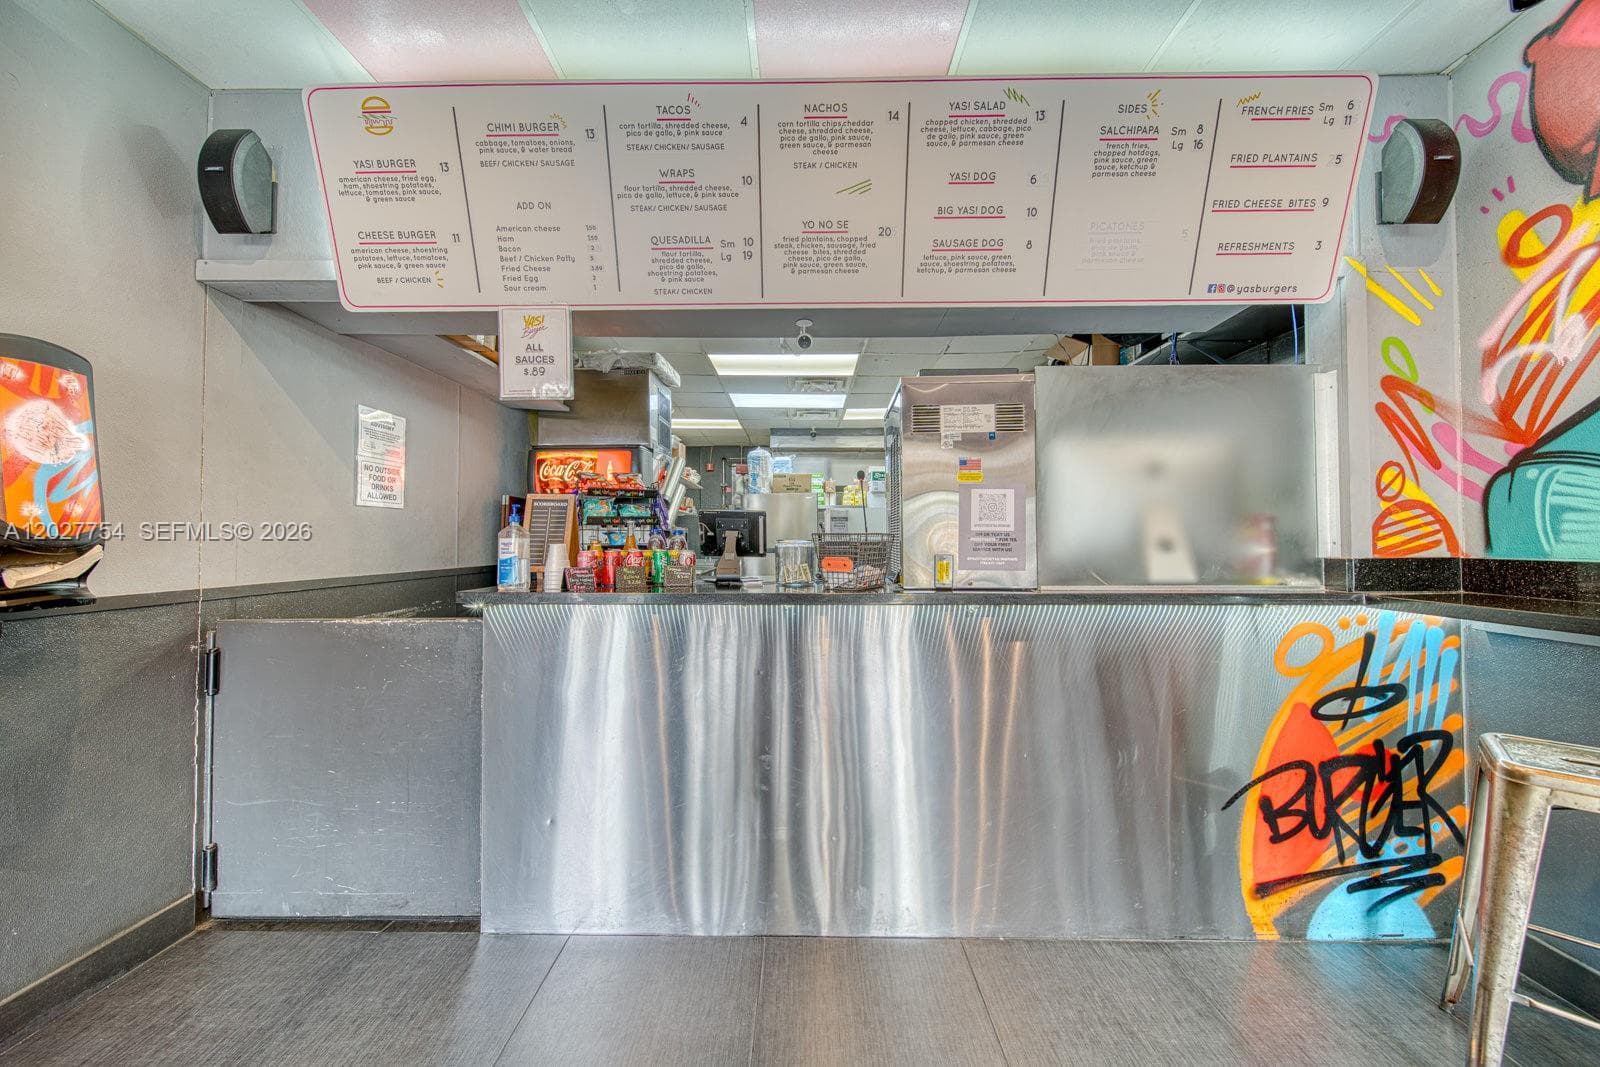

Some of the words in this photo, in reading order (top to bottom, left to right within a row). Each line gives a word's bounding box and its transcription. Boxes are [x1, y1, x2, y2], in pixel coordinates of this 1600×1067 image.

[804, 103, 847, 112] NACHOS
[888, 111, 899, 121] 14
[973, 101, 1006, 111] SALAD
[1035, 110, 1045, 121] 13
[1118, 104, 1147, 113] SIDES
[1242, 106, 1283, 115] FRENCH
[1286, 106, 1314, 115] FRIES
[1319, 103, 1334, 111] Sm
[1346, 100, 1354, 110] 6
[656, 104, 691, 115] TACOS
[740, 116, 747, 126] 4
[993, 118, 1027, 126] shredded
[1323, 116, 1334, 126] Lg
[1344, 115, 1352, 125] 11
[487, 123, 516, 132] CHIMI
[519, 122, 559, 132] BURGER
[585, 129, 595, 139] 13
[665, 122, 699, 130] shredded
[1100, 126, 1159, 135] SALCHIPAPA
[1171, 127, 1186, 136] Sm
[1197, 124, 1203, 134] 8
[1172, 141, 1183, 151] Lg
[1193, 139, 1203, 149] 16
[540, 159, 575, 168] SAUSAGE
[1231, 154, 1259, 163] FRIED
[1262, 153, 1317, 163] PLANTAINS
[1335, 154, 1342, 164] 5
[376, 159, 416, 168] BURGER
[439, 162, 449, 172] 13
[1120, 163, 1148, 171] ketchup
[659, 168, 695, 178] WRAPS
[742, 176, 752, 185] 10
[973, 172, 996, 181] DOG
[1030, 175, 1037, 184] 6
[517, 202, 534, 210] ADD
[538, 202, 551, 210] ON
[694, 204, 727, 212] SAUSAGE
[1212, 200, 1240, 208] FRIED
[1244, 199, 1283, 208] CHEESE
[1288, 199, 1316, 208] BITES
[1322, 198, 1329, 207] 9
[938, 206, 953, 215] BIG
[981, 206, 1003, 215] DOG
[1027, 207, 1038, 217] 10
[534, 224, 560, 232] cheese
[802, 220, 815, 229] YO
[819, 220, 833, 229] NO
[837, 220, 848, 229] SE
[878, 226, 891, 238] 20
[358, 231, 395, 240] CHEESE
[398, 231, 436, 240] BURGER
[452, 233, 460, 243] 11
[651, 236, 711, 246] QUESADILLA
[720, 240, 735, 248] Sm
[743, 237, 754, 247] 10
[933, 239, 978, 248] SAUSAGE
[982, 239, 1005, 247] DOG
[1026, 240, 1032, 249] 8
[1218, 242, 1296, 252] REFRESHMENTS
[1315, 241, 1322, 250] 3
[499, 255, 516, 263] Beef
[524, 255, 554, 264] Chicken
[556, 255, 575, 263] Patty
[721, 253, 731, 262] Lg
[742, 251, 753, 261] 19
[502, 275, 521, 283] Fried
[524, 275, 539, 283] Egg
[1227, 284, 1297, 294] @yasburgers
[515, 356, 555, 364] SAUCES
[523, 367, 545, 376] $.89
[369, 474, 386, 483] FOOD
[371, 483, 394, 492] DRINKS
[367, 492, 397, 501] ALLOWED
